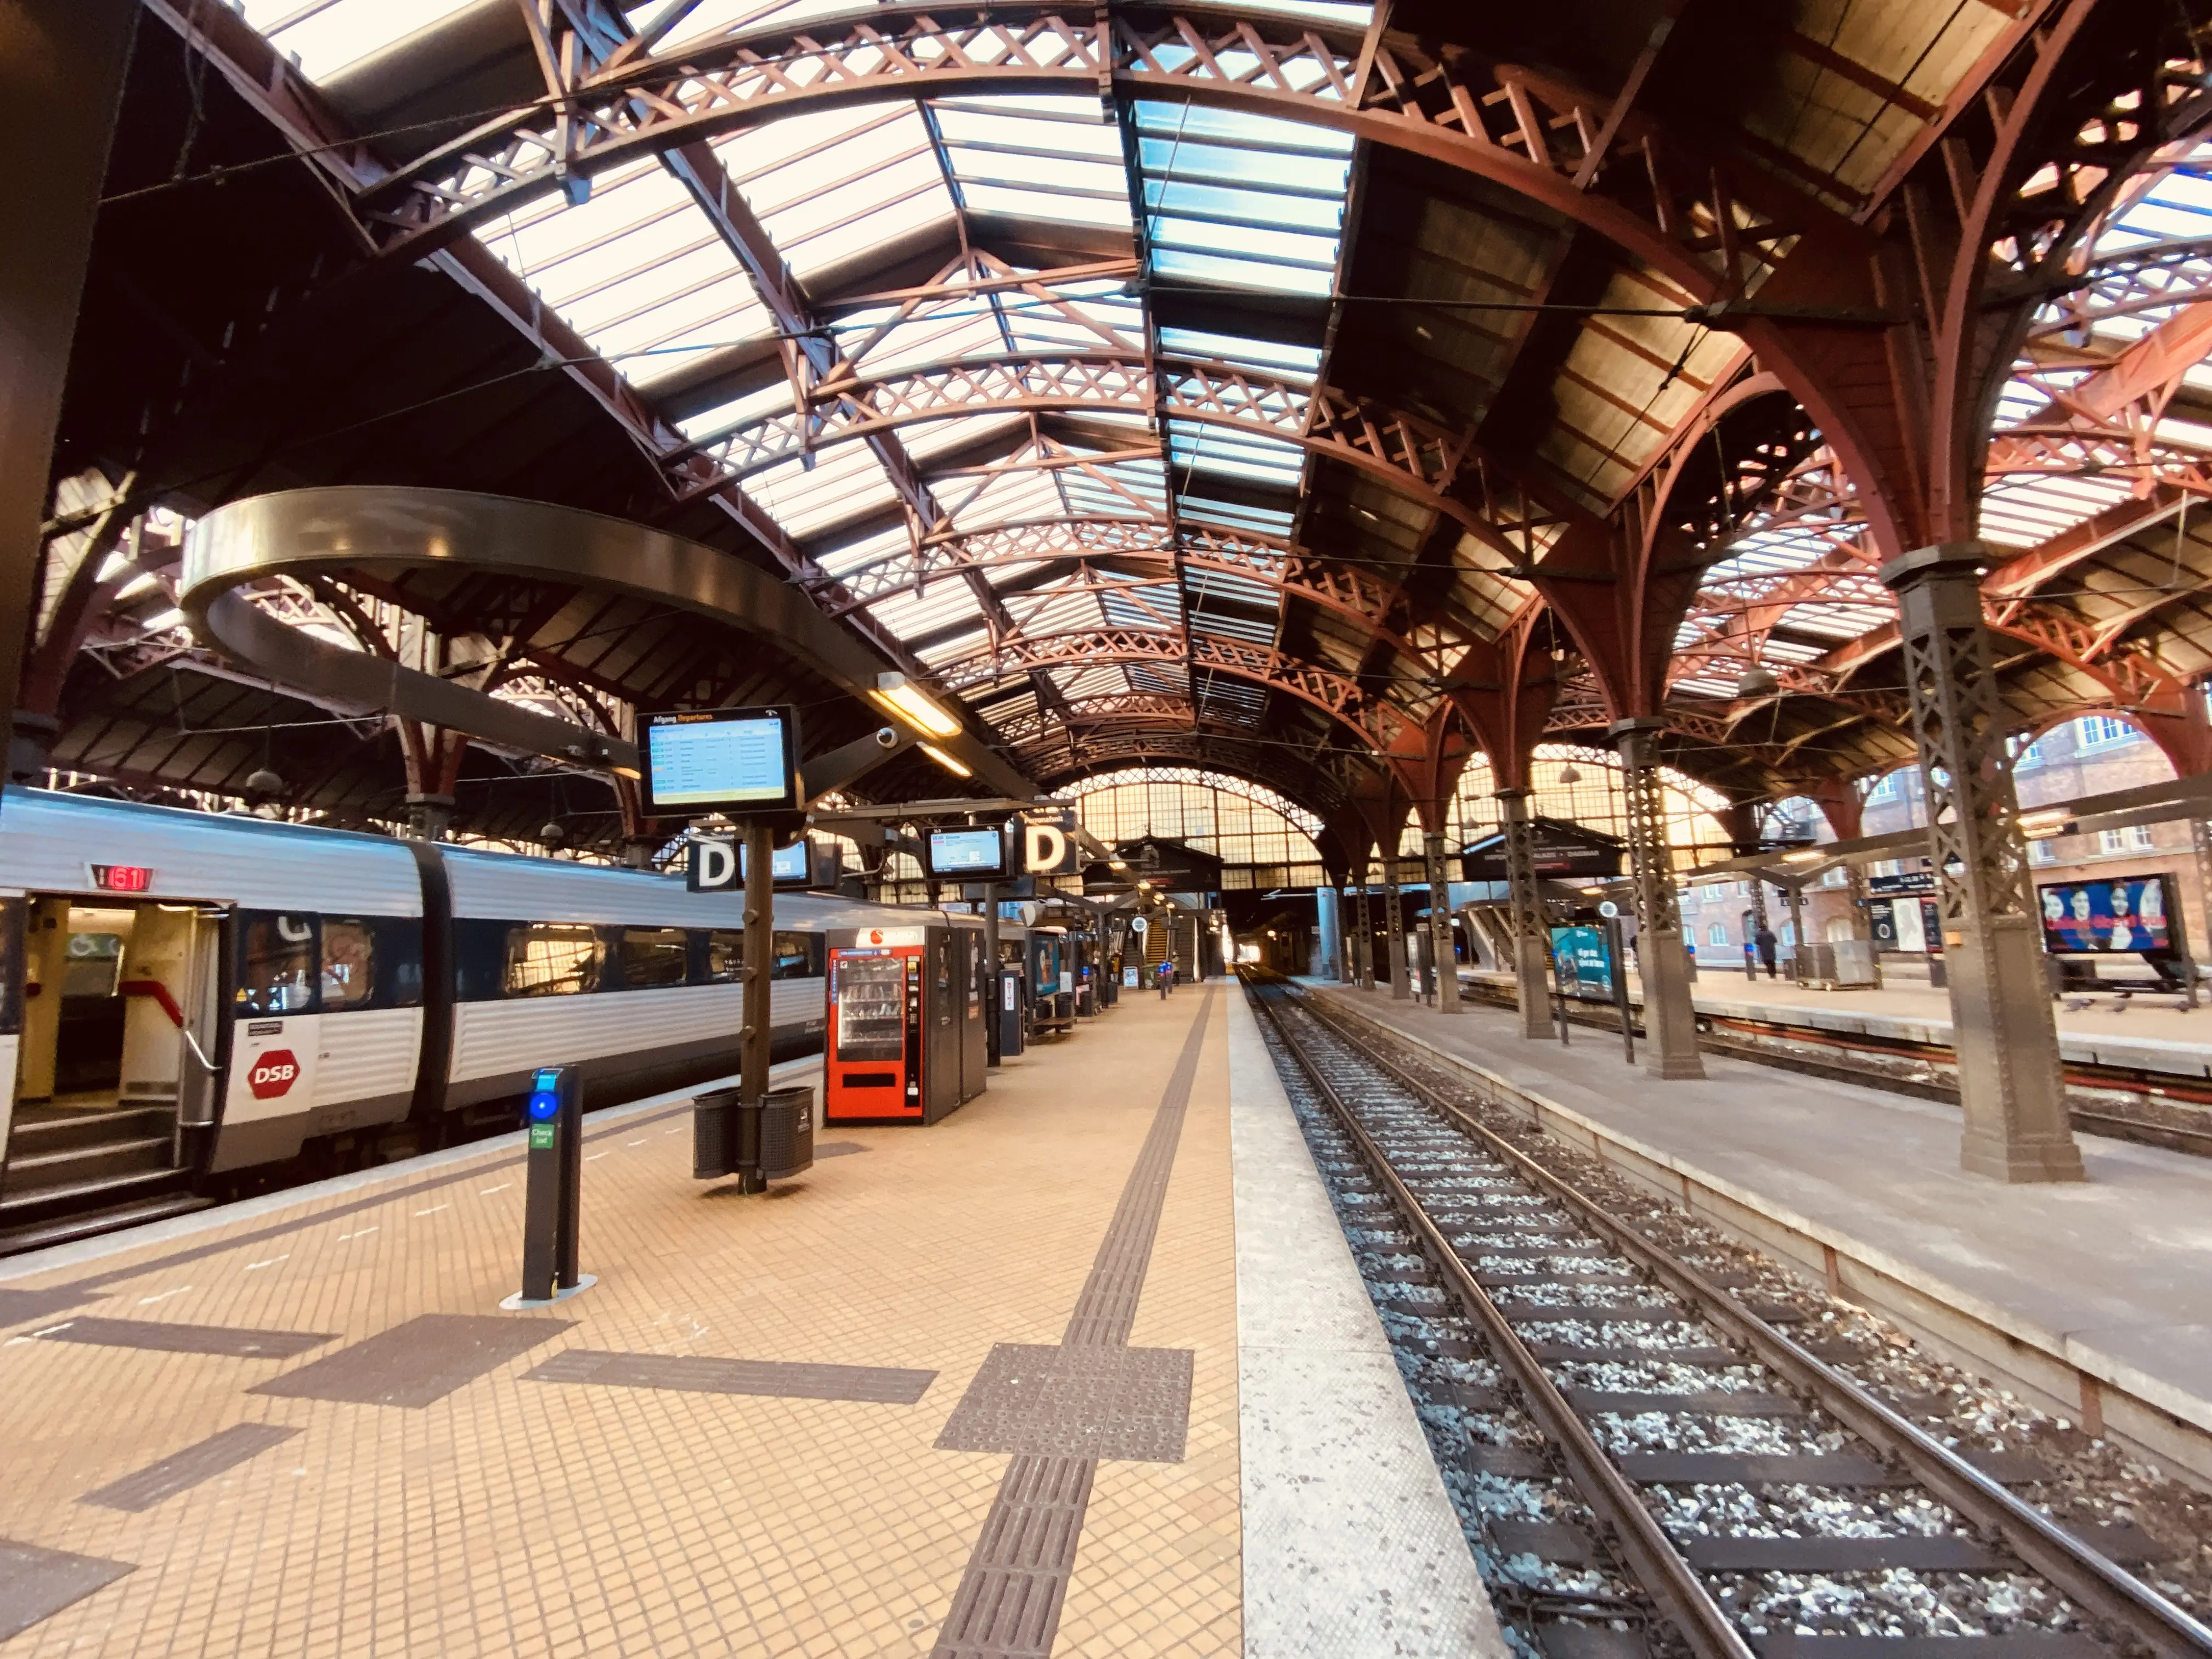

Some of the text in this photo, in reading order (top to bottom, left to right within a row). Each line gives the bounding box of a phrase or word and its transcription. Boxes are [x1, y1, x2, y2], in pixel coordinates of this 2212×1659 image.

[653, 714, 713, 725] Afgang Departures
[1025, 825, 1065, 871] D
[699, 843, 736, 887] D
[255, 1064, 295, 1084] DSB
